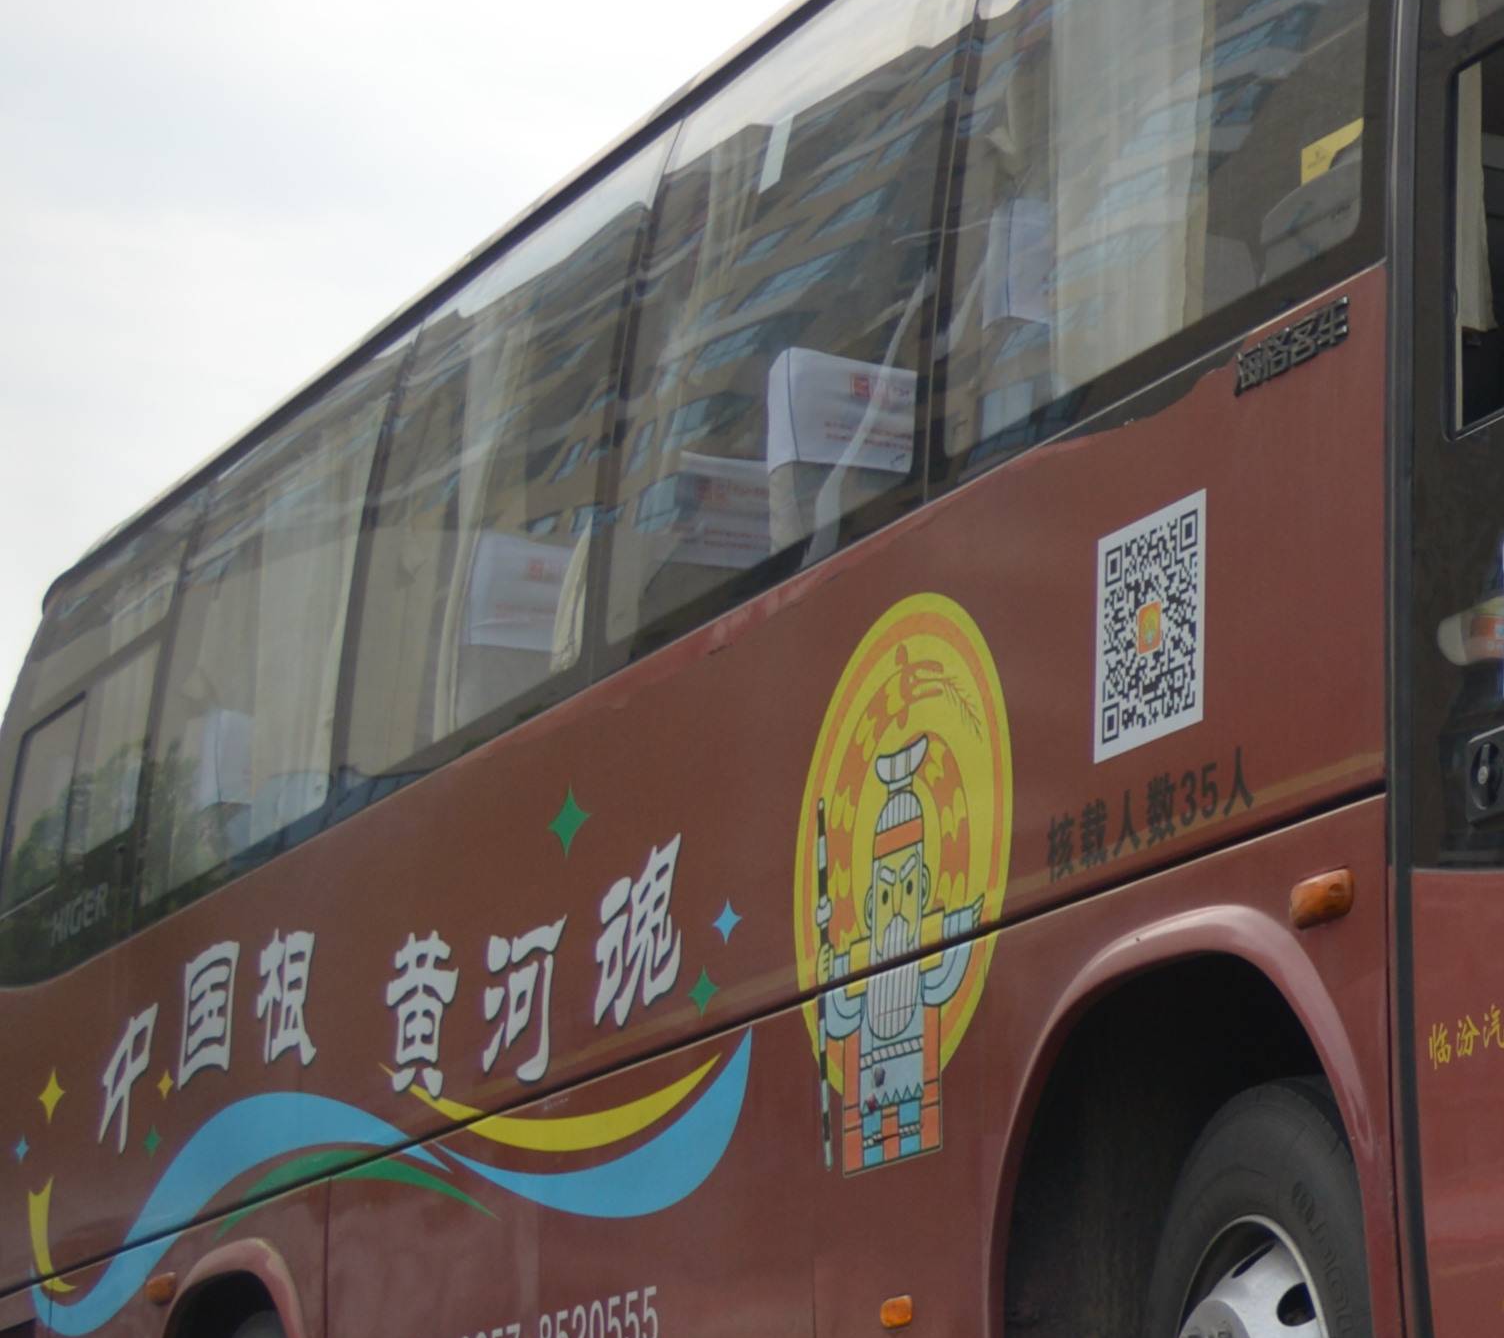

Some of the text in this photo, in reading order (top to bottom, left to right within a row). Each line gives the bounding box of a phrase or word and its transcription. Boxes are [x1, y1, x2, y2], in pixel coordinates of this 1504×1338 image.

[1235, 295, 1350, 397] 海格客车
[1046, 747, 1255, 884] 核载人数35人
[50, 882, 109, 949] HIGER
[96, 833, 682, 1153] 中国根 黄河魂
